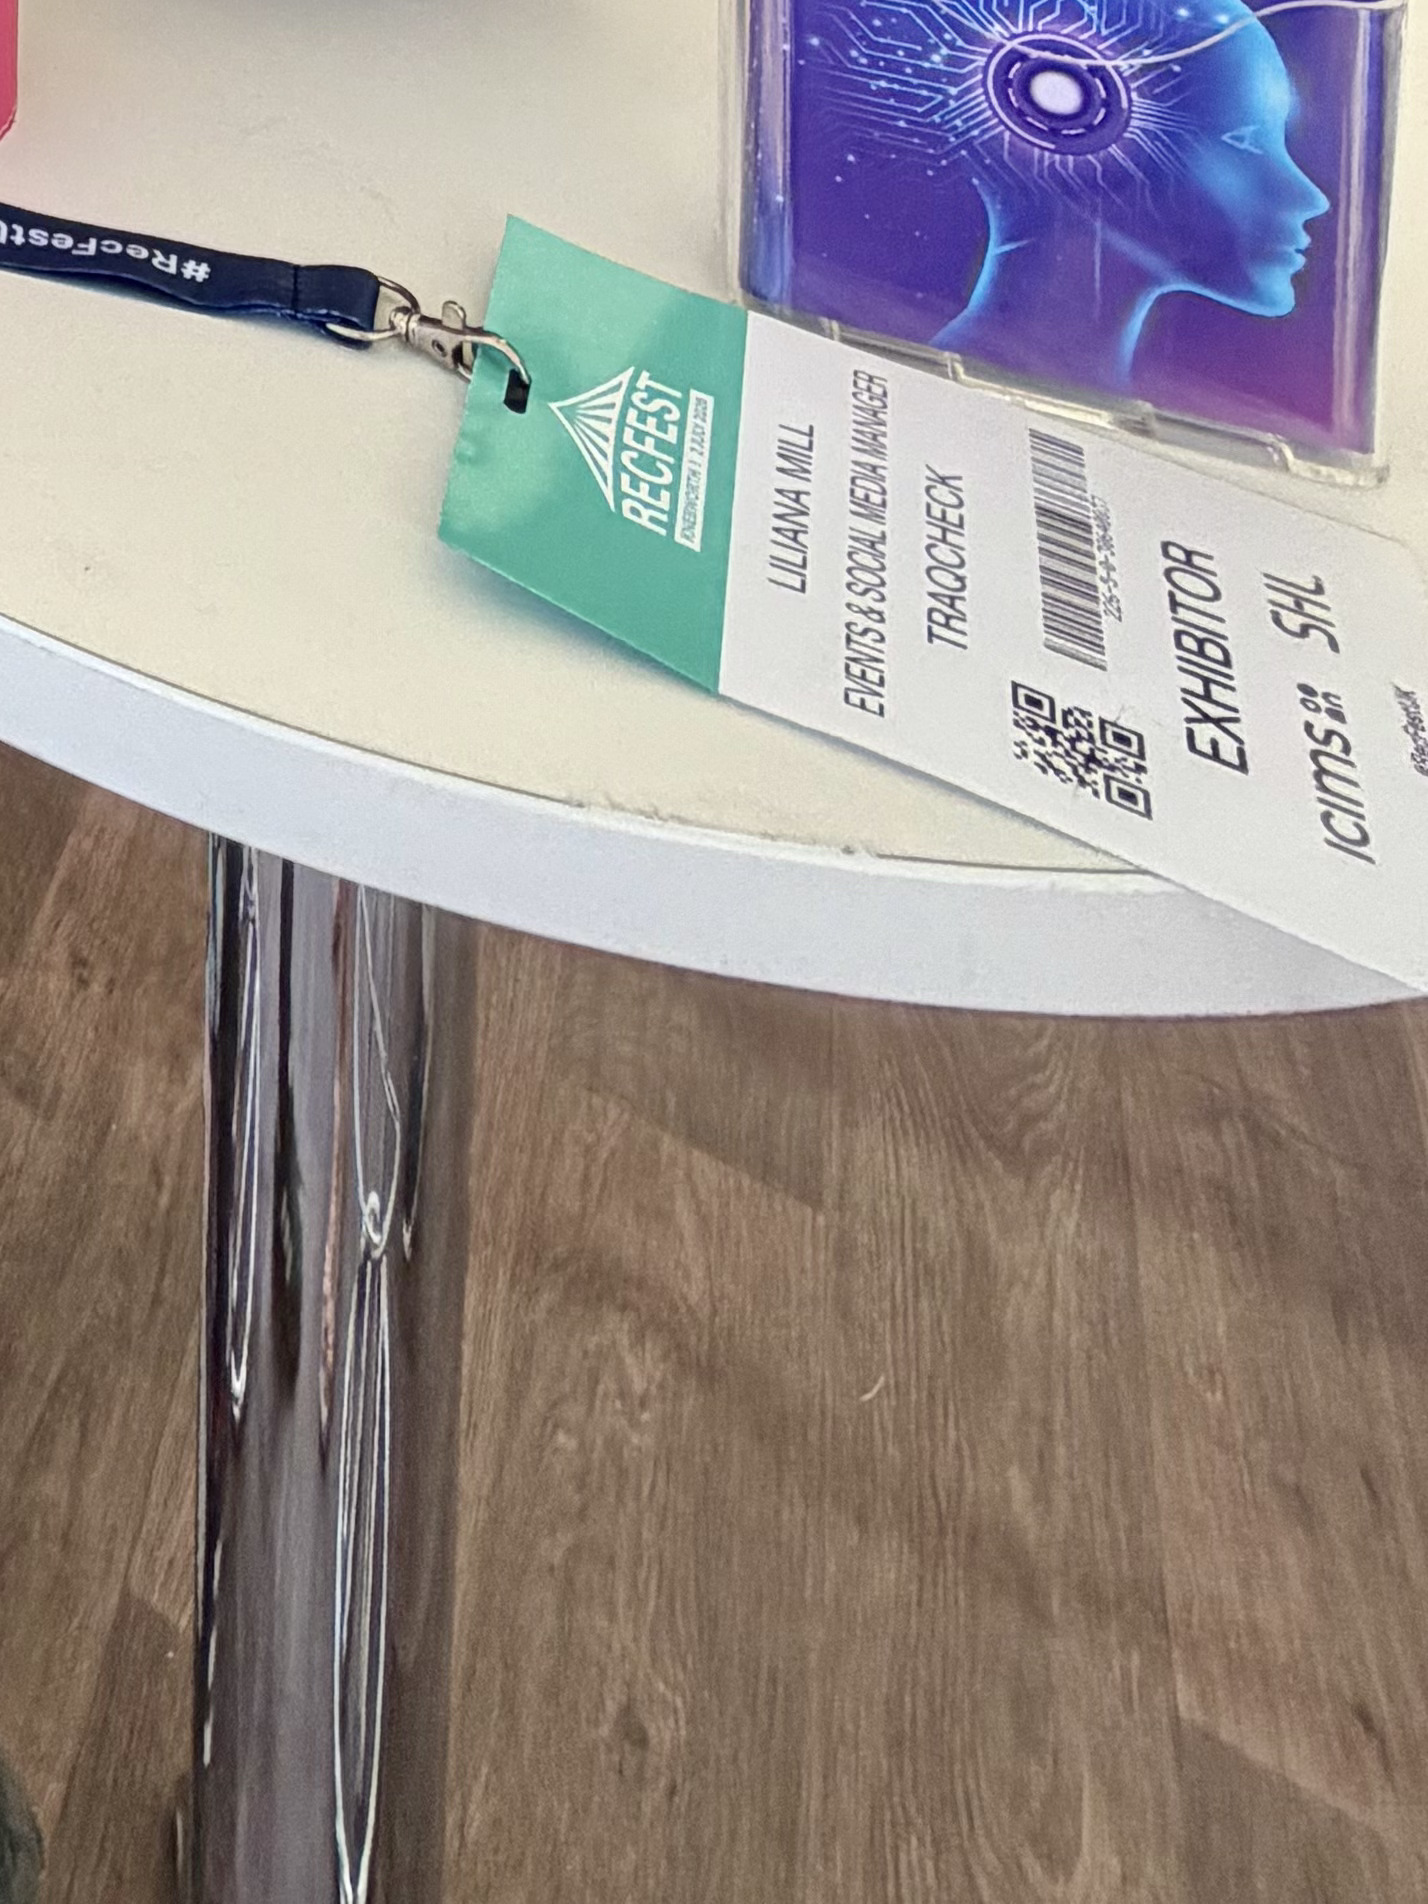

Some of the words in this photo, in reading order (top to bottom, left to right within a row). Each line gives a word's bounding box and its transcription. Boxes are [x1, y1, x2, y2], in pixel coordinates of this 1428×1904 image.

[620, 369, 683, 537] RECFEST
[775, 422, 815, 483] MILL
[851, 368, 889, 462] MANAGER
[848, 459, 888, 526] MEDIA
[767, 487, 812, 595] LILIANA
[845, 526, 888, 605] SOCIAL
[925, 462, 968, 652] TRAQCHECK
[844, 601, 887, 625] &
[1160, 539, 1249, 775] EXHIBITOR
[1261, 571, 1340, 655] SHL
[843, 621, 887, 718] EVENTS
